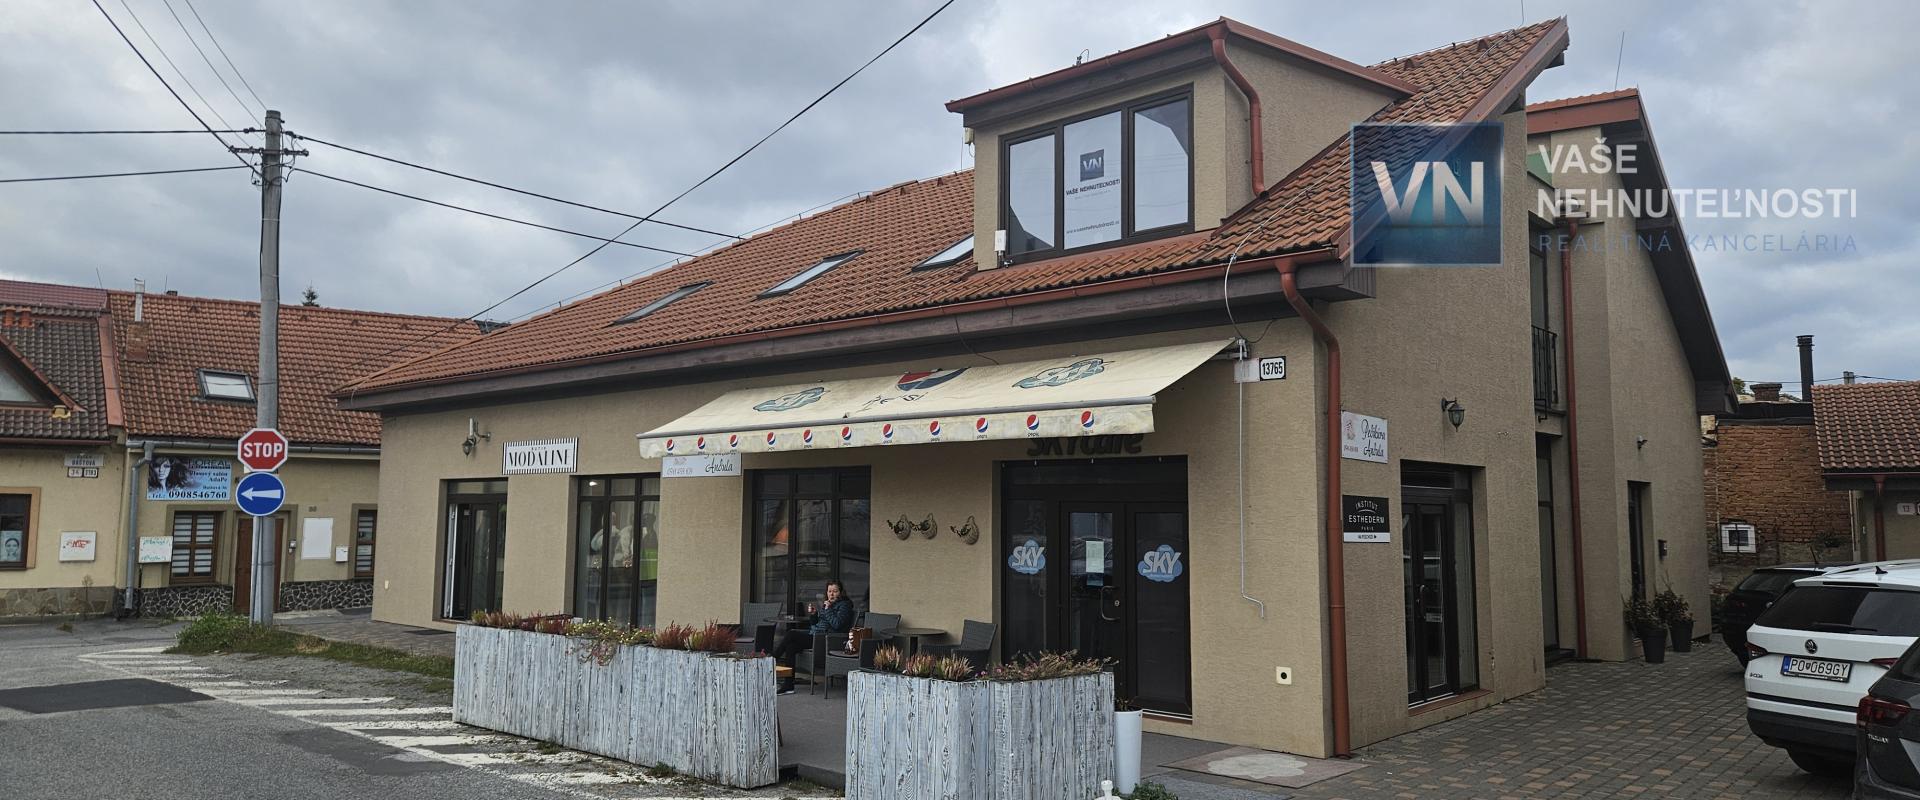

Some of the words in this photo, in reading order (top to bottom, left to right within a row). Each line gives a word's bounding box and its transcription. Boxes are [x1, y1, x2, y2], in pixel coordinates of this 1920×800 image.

[1083, 157, 1102, 171] VN
[1262, 361, 1283, 375] 13765
[243, 442, 283, 458] STOP
[509, 449, 571, 467] MODALINE
[168, 491, 228, 499] 0908546760
[1355, 500, 1378, 511] INSTITUT
[1348, 514, 1385, 524] ESTHEDERM
[1012, 545, 1045, 568] SKY
[1143, 551, 1182, 574] SKY
[1811, 661, 1848, 677] 069GY
